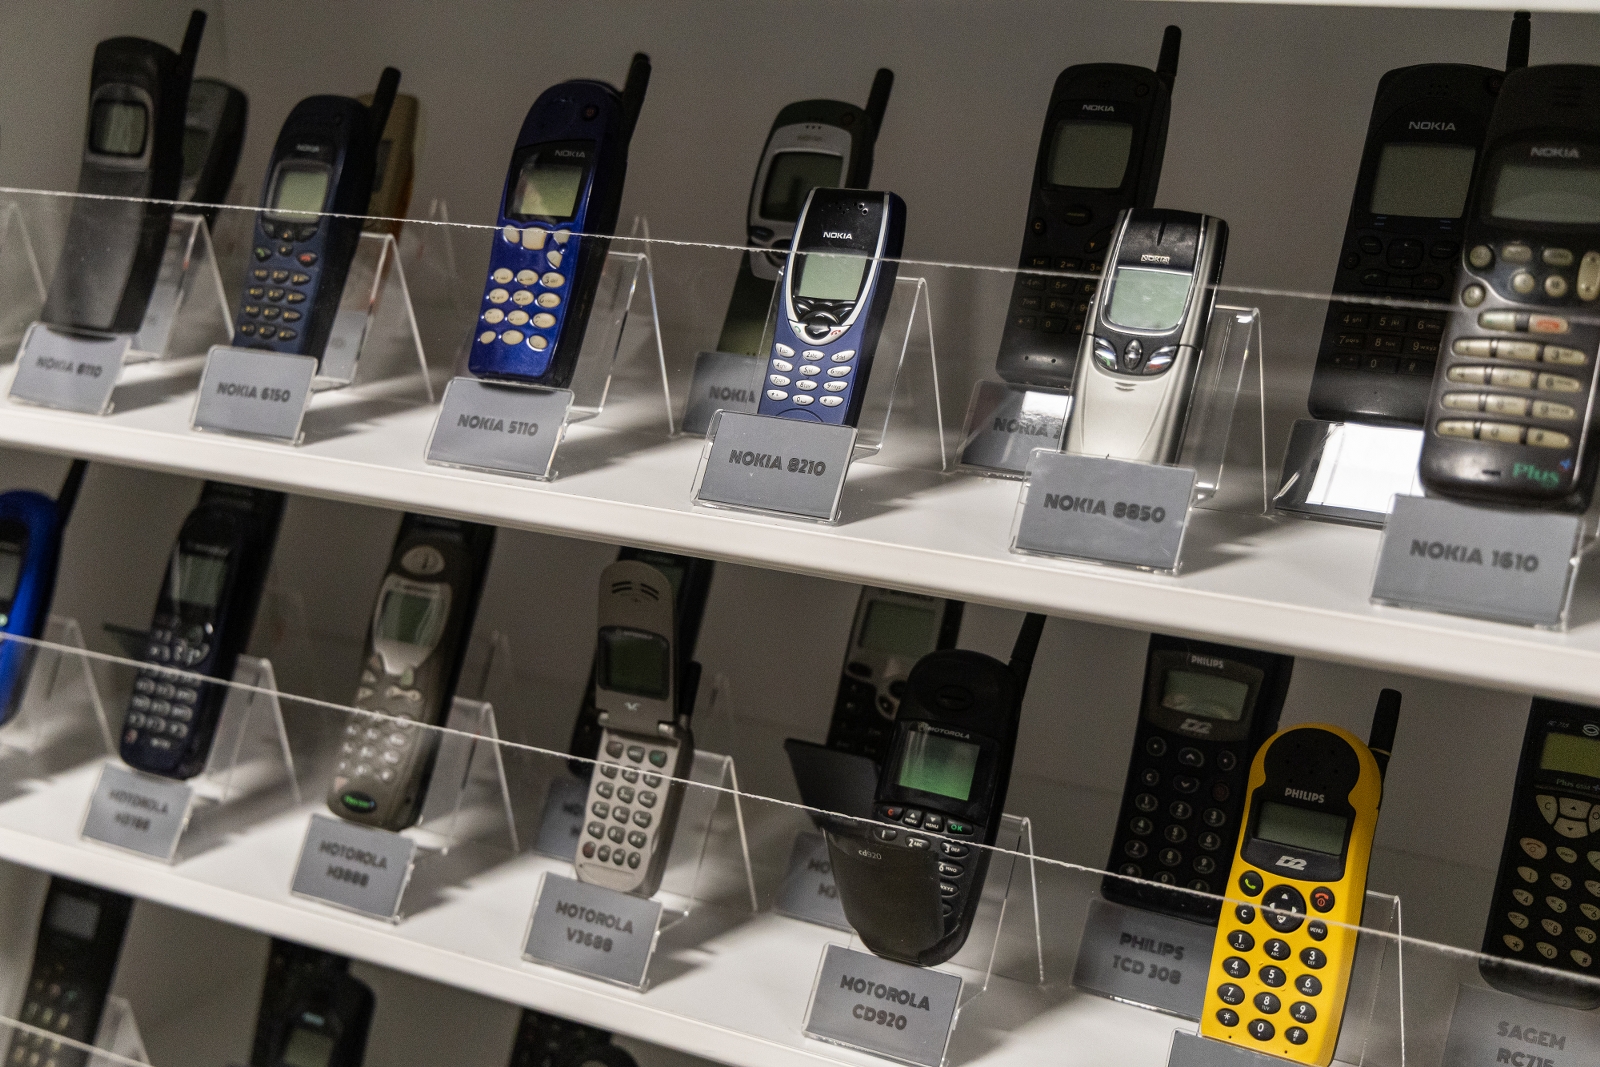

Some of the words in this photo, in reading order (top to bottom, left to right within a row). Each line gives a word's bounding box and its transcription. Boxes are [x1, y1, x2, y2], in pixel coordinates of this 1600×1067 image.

[1082, 104, 1115, 112] NOKIA
[1408, 121, 1456, 131] NOKIA
[554, 150, 586, 158] NOKIA
[1530, 147, 1580, 159] NOKIA
[823, 231, 853, 241] NOKIA
[1141, 254, 1171, 265] NOKIA
[217, 382, 257, 398] NOKIA
[261, 387, 291, 402] 6150
[709, 385, 756, 404] NOKIA
[457, 414, 504, 432] NOKIA
[508, 421, 539, 437] 5110
[729, 450, 782, 471] NOKIA
[787, 457, 827, 477] 8210
[1512, 462, 1560, 489] Plus
[1044, 493, 1107, 516] NOKIA
[1112, 501, 1166, 523] 8850
[1409, 539, 1483, 566] NOKIA
[1491, 549, 1540, 573] 1610
[1191, 655, 1225, 670] PHILIPS
[928, 725, 971, 740] MOTOROLA
[1284, 787, 1326, 804] PHILIPS
[951, 823, 963, 831] OK
[320, 841, 388, 869] MOTOROLA
[858, 849, 882, 860] cd920
[1561, 879, 1569, 888] 2
[1523, 896, 1529, 904] 4
[1556, 902, 1563, 911] 5
[555, 900, 633, 934] MOTOROLA
[1240, 909, 1248, 918] C
[1591, 910, 1598, 918] 6
[1519, 917, 1526, 926] 7
[1309, 926, 1325, 935] MENU
[1552, 925, 1559, 934] 8
[567, 927, 614, 952] V3688
[1587, 933, 1594, 941] 9
[1120, 932, 1184, 960] PHILIPS
[1273, 942, 1280, 952] 2
[1309, 950, 1316, 961] 3
[1546, 948, 1553, 957] 0
[1113, 954, 1145, 975] TCD
[1148, 963, 1182, 985] 308
[1231, 961, 1239, 970] 4
[1268, 969, 1275, 979] 5
[1304, 978, 1311, 987] 6
[840, 974, 931, 1012] MOTOROLA
[1227, 987, 1234, 996] 7
[1263, 995, 1270, 1006] 8
[1299, 1004, 1306, 1014] 9
[852, 1003, 908, 1031] CD920
[1257, 1022, 1265, 1033] 0
[1496, 1020, 1567, 1051] SAGEM
